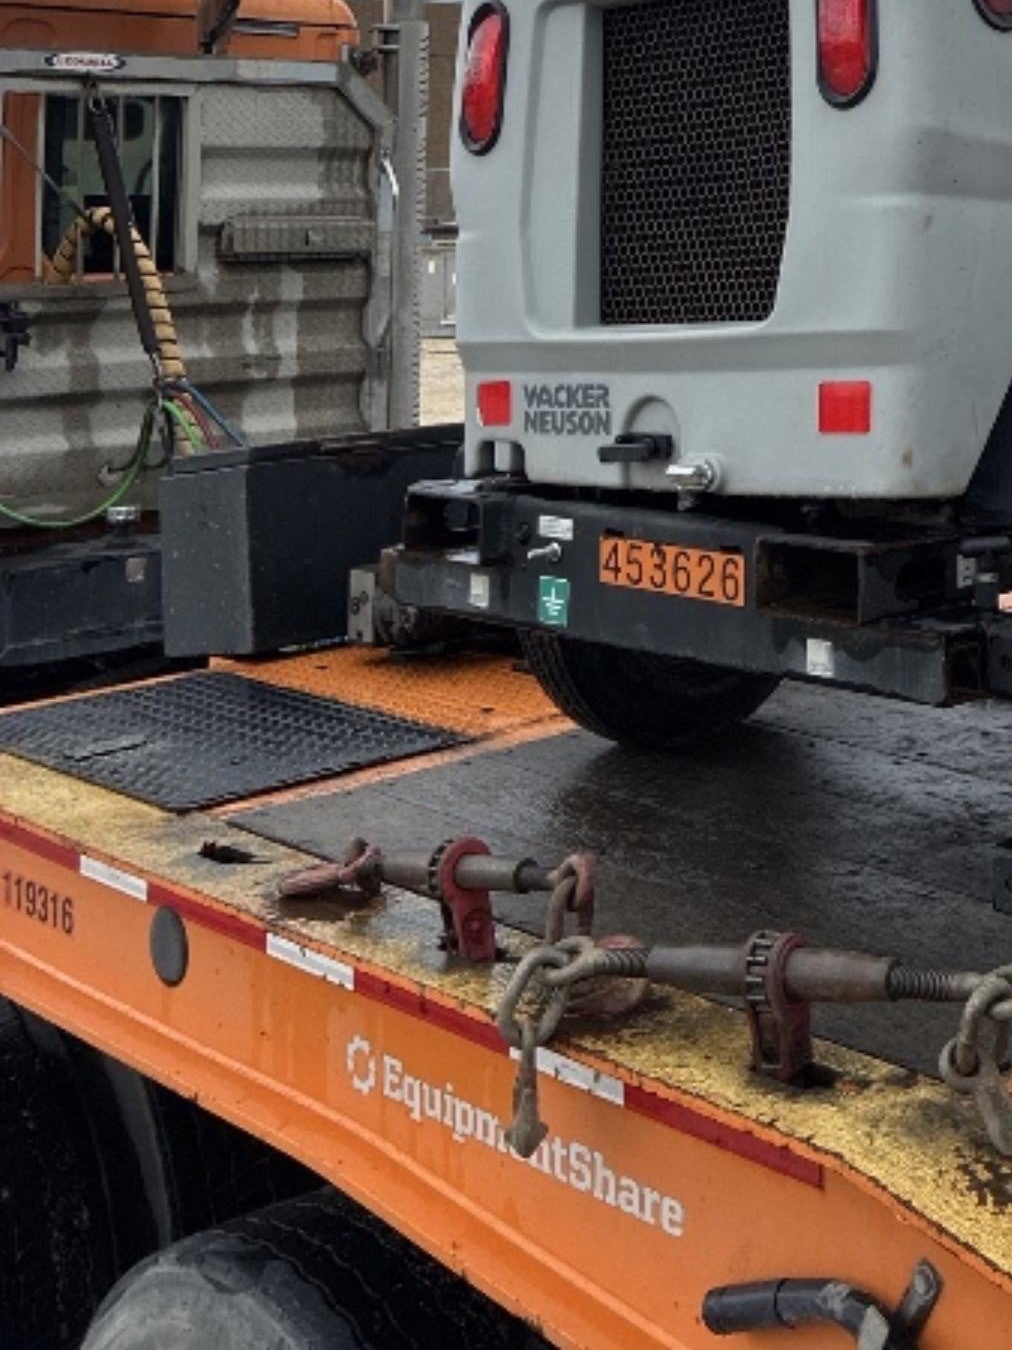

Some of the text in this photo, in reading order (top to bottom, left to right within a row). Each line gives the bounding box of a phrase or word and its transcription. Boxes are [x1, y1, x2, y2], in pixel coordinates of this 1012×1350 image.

[524, 383, 610, 408] WACKER
[524, 410, 611, 435] NEUSON
[603, 542, 739, 600] 453626
[2, 870, 75, 935] 119316
[383, 1054, 685, 1237] EquipmntShare
